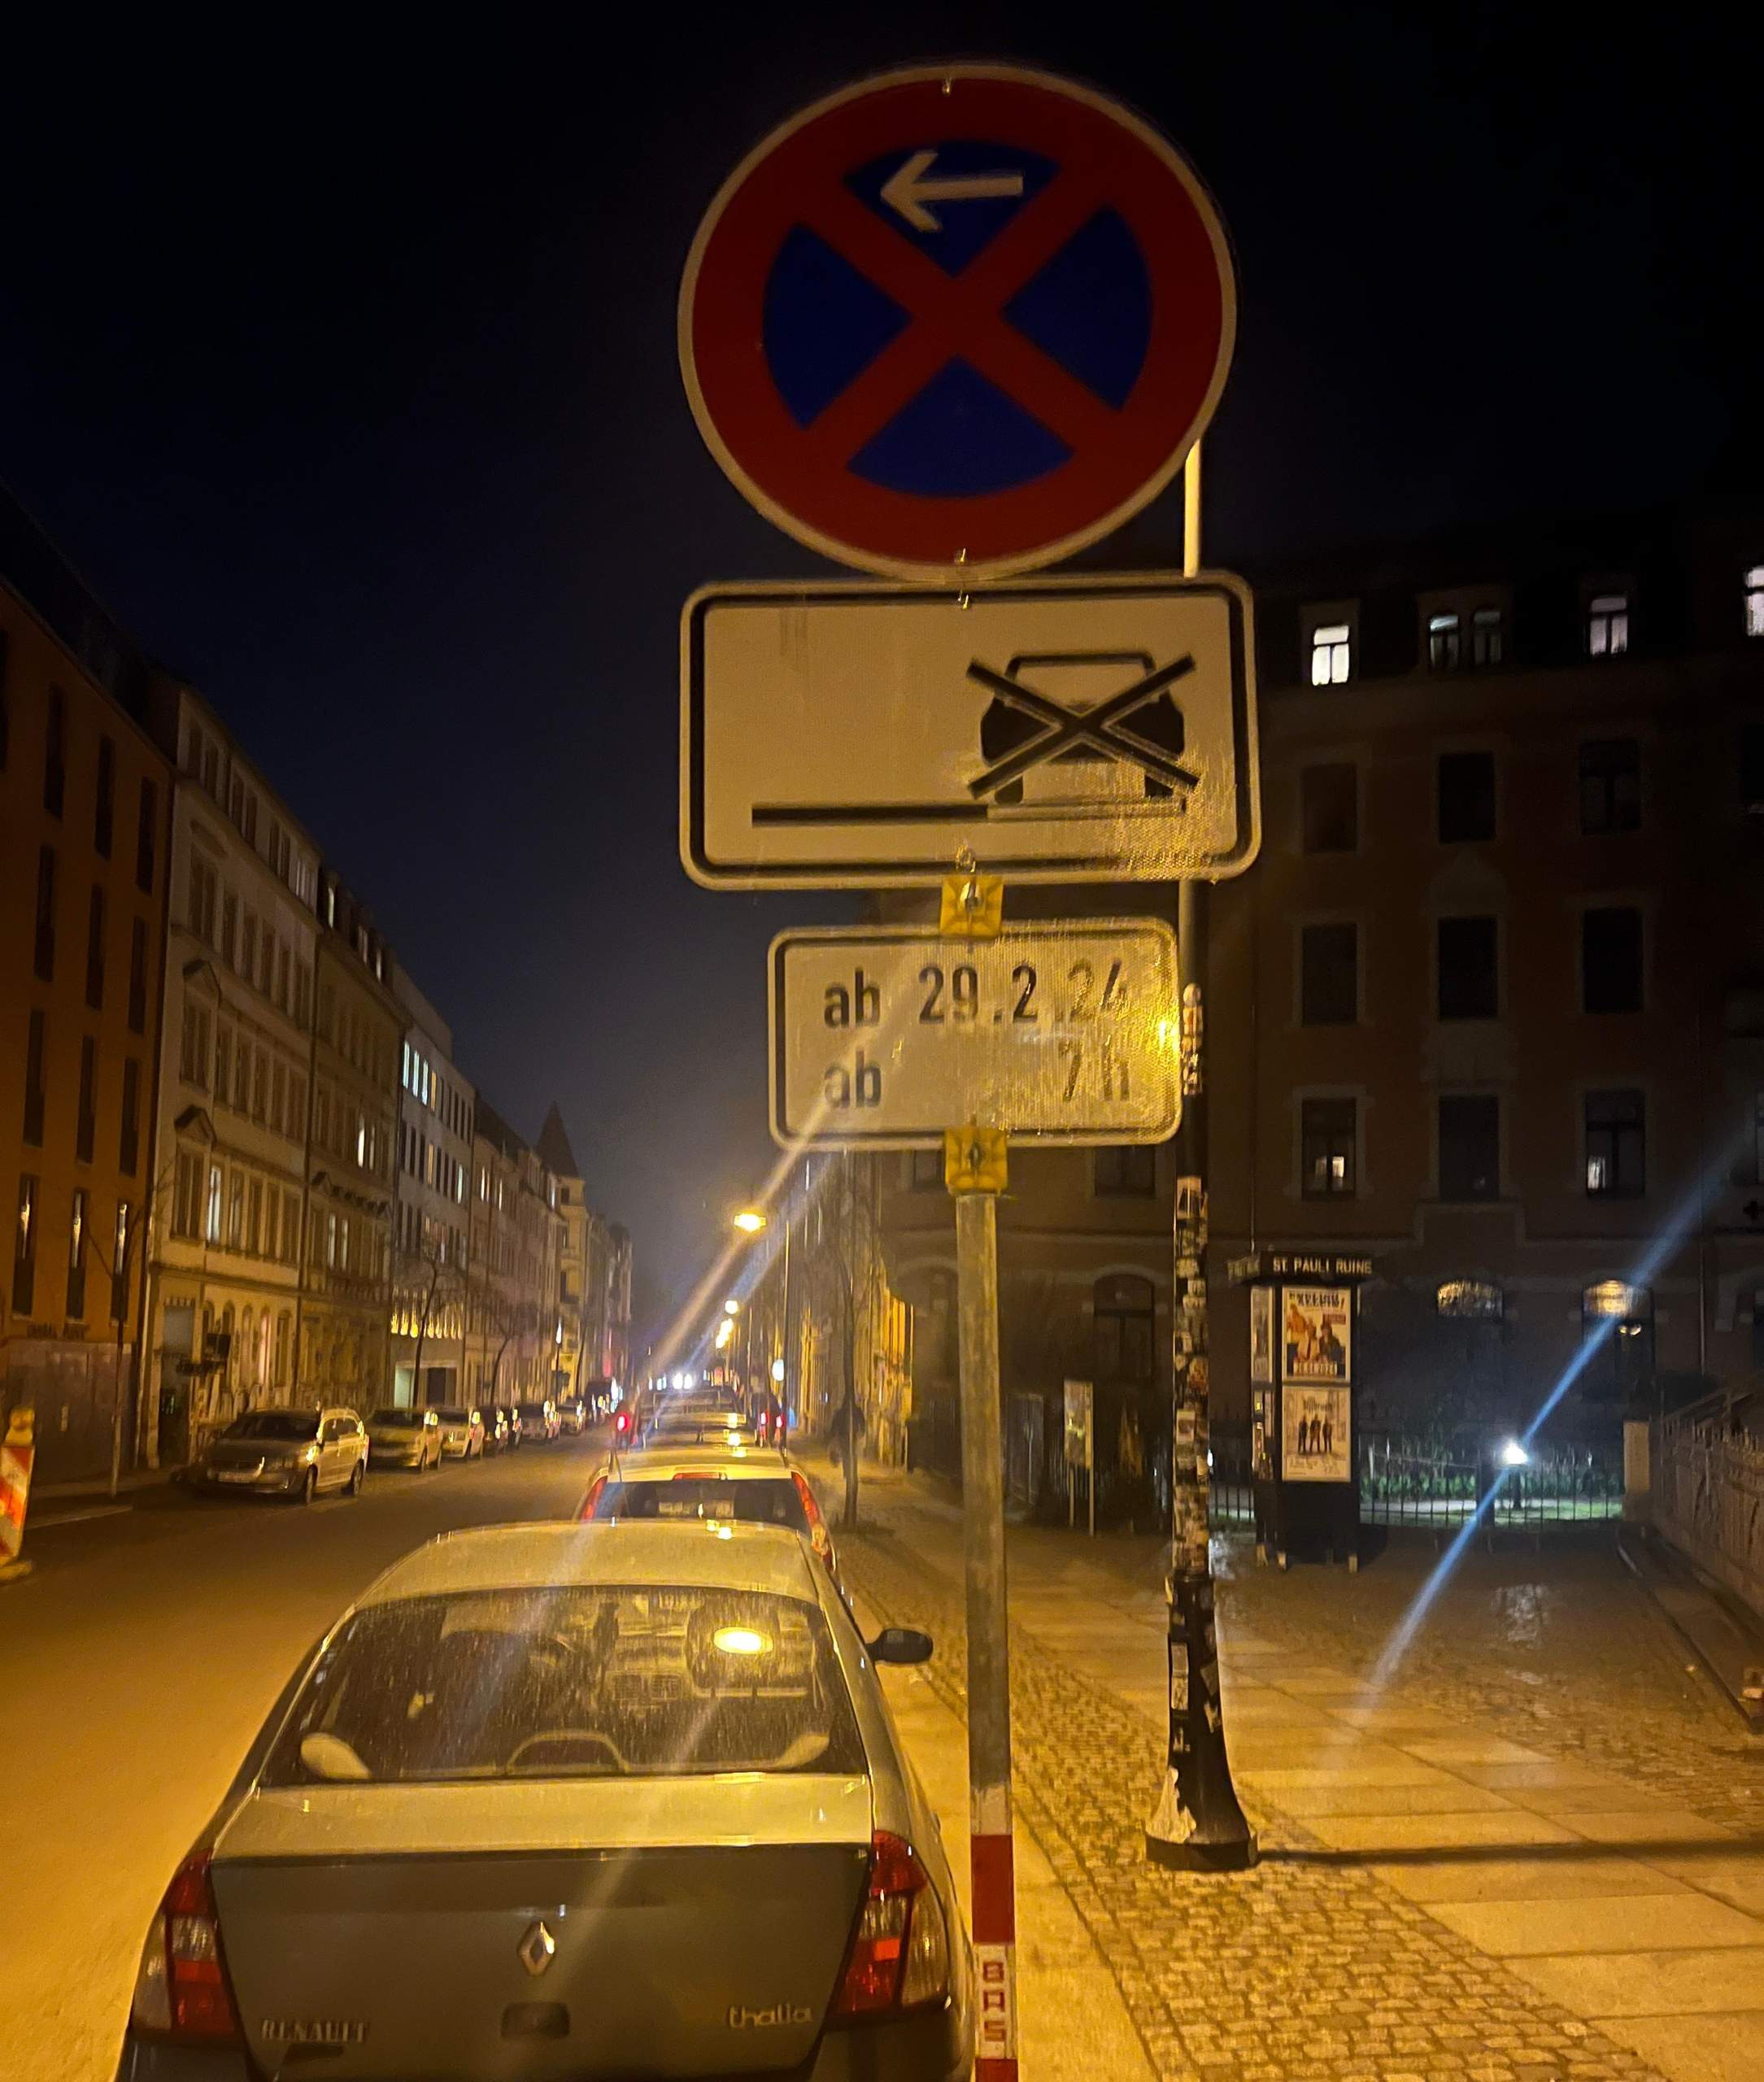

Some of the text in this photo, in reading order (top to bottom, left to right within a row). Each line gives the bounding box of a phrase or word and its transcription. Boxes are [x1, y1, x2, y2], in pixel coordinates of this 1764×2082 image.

[824, 966, 881, 1028] ab
[824, 1050, 882, 1109] ab
[1294, 1257, 1330, 1275] PAULI
[1335, 1258, 1372, 1275] RUINE
